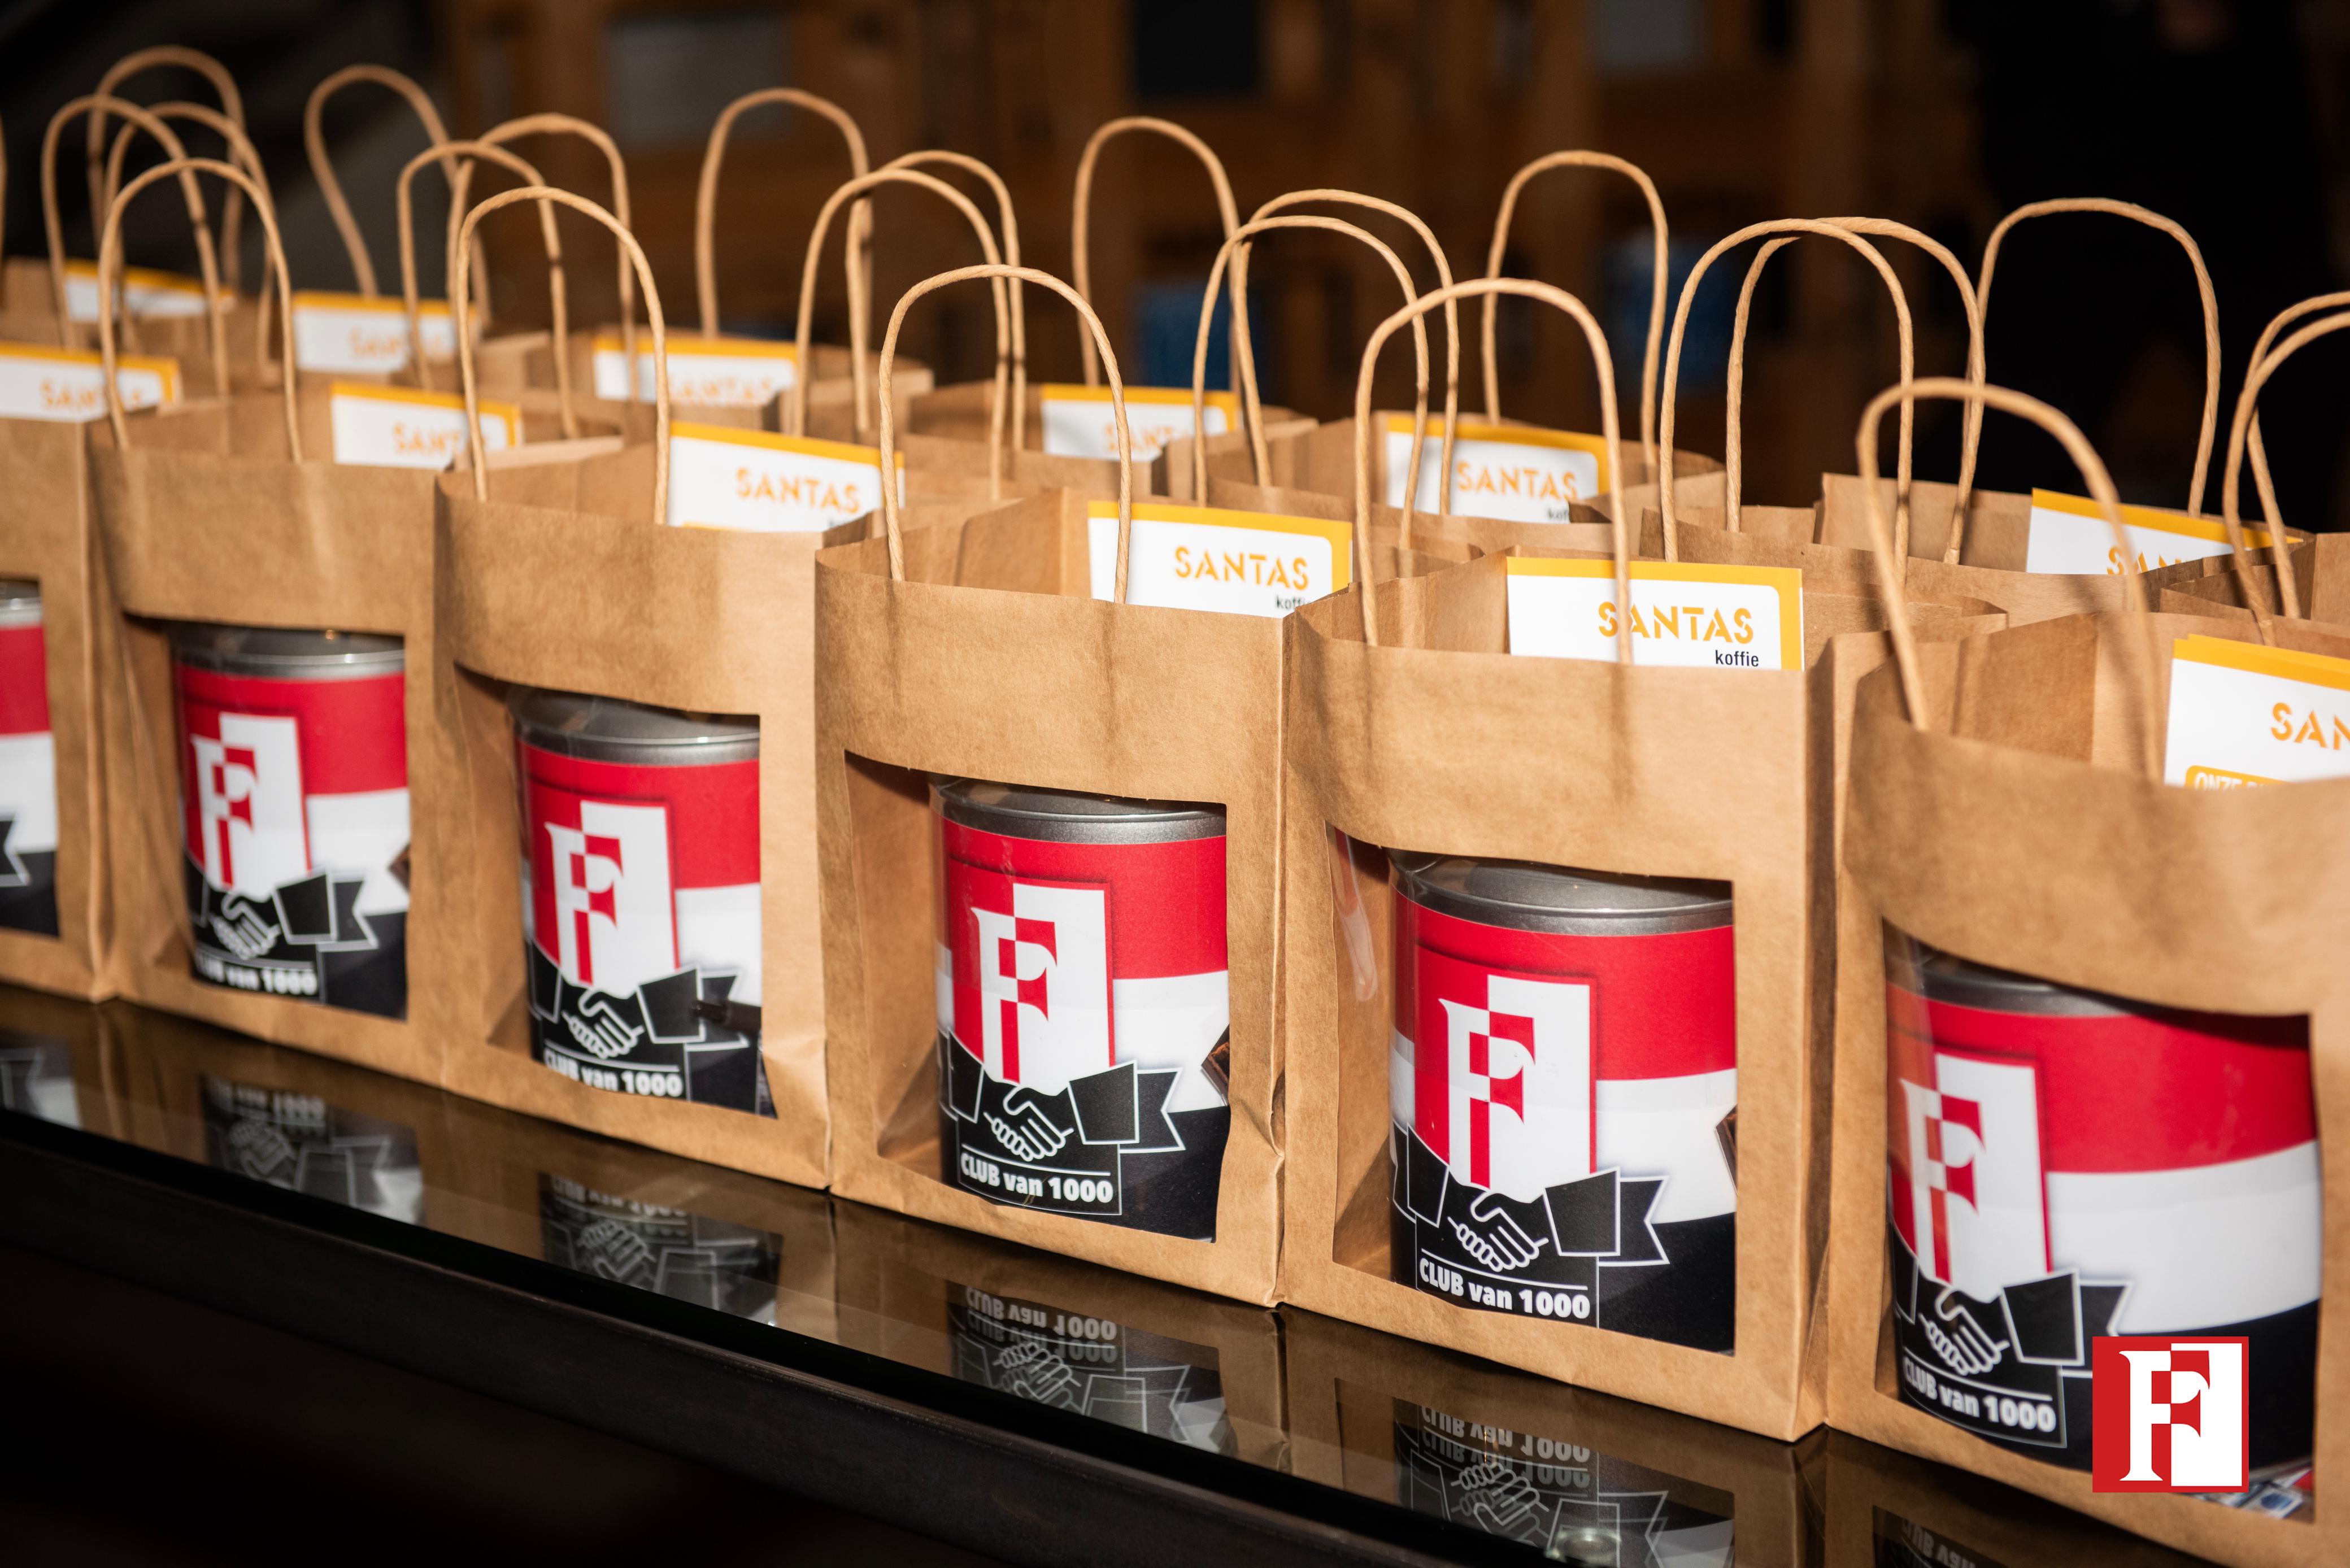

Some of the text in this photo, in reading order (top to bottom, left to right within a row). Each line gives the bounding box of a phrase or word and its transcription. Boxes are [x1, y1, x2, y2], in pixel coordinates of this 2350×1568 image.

[736, 467, 861, 515] SANTAS
[1456, 460, 1578, 502] SANTAS
[1174, 546, 1310, 591] SANTAS
[1598, 601, 1754, 644] SANTAS
[1715, 650, 1759, 667] koffie
[621, 1070, 683, 1097] 1000
[960, 1151, 1114, 1204] CLUB van 1000
[1419, 1257, 1591, 1319] CLUB van 1000
[1904, 1356, 2057, 1433] CLUB van 1000
